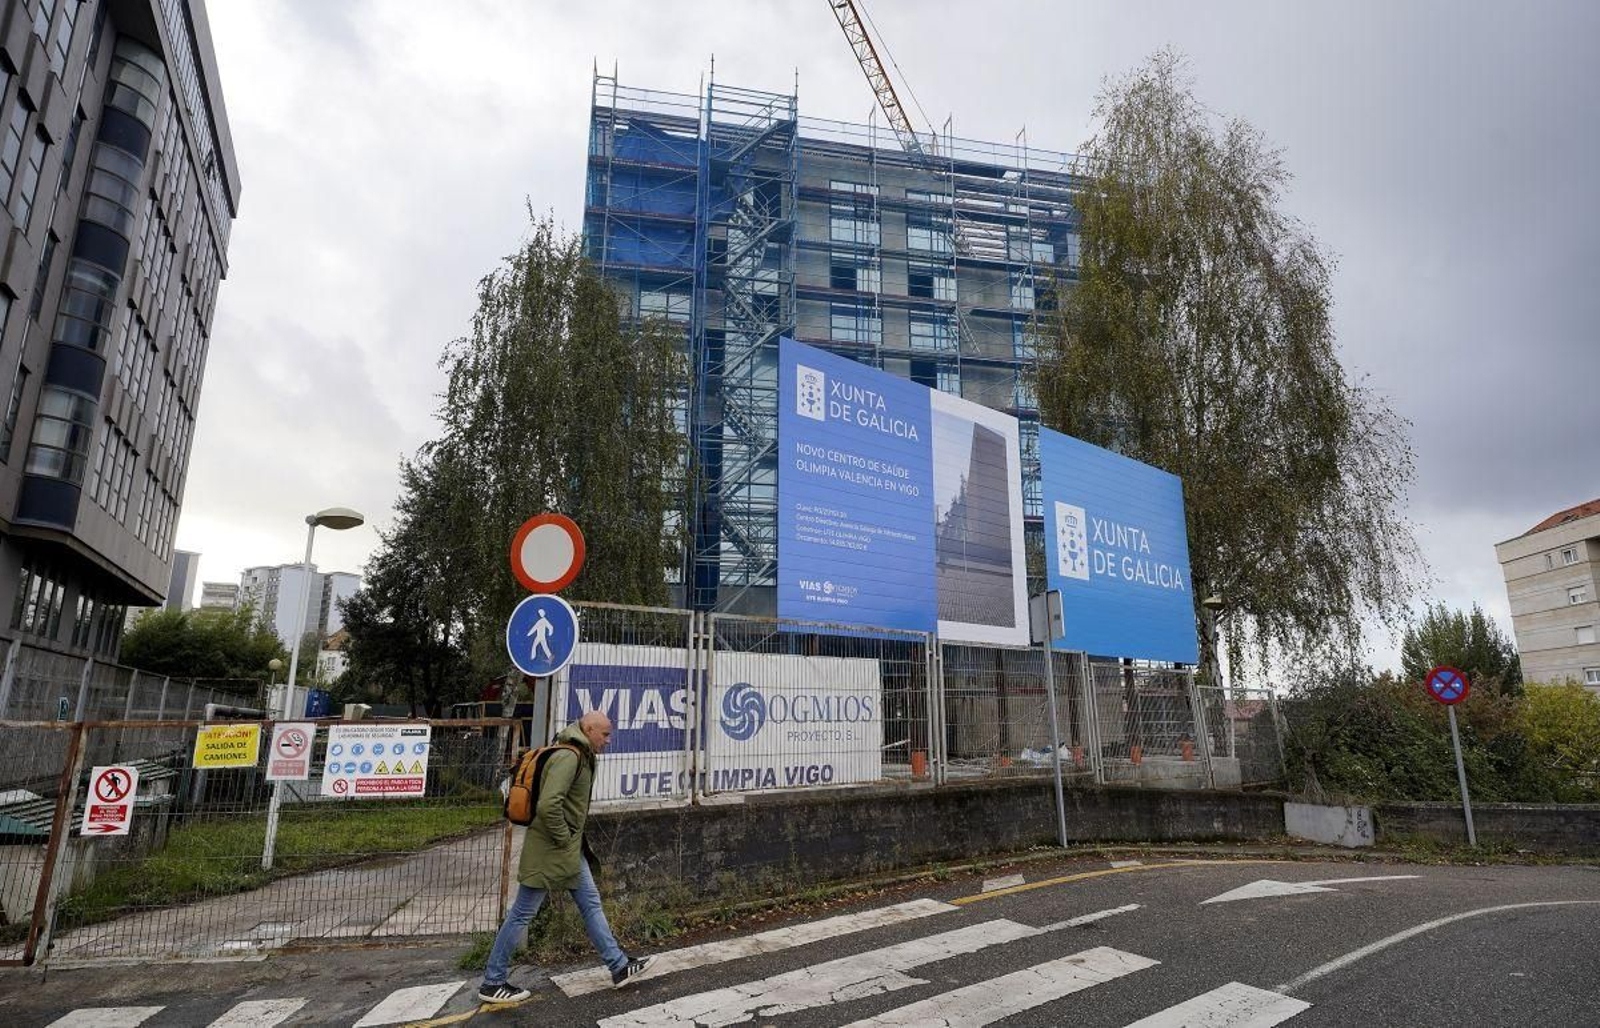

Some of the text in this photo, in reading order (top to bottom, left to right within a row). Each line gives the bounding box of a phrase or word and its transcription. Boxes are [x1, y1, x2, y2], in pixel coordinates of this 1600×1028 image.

[831, 379, 886, 412] XUNTA
[829, 400, 919, 441] DE GALICIA
[796, 441, 910, 480] NOVO CENTRO DE SAÚDE
[796, 459, 919, 497] OLIMPIA VALENCIA EN VIGO
[1092, 516, 1150, 554] XUNTA
[799, 579, 821, 591] VIAS
[1094, 549, 1185, 591] DE GALICIA
[575, 688, 696, 730] VIAS
[768, 694, 874, 724] OGMIOS
[203, 752, 247, 761] CAMIONES
[205, 742, 235, 750] SALIDA
[620, 771, 672, 796] UTE
[785, 764, 834, 785] VIGO
